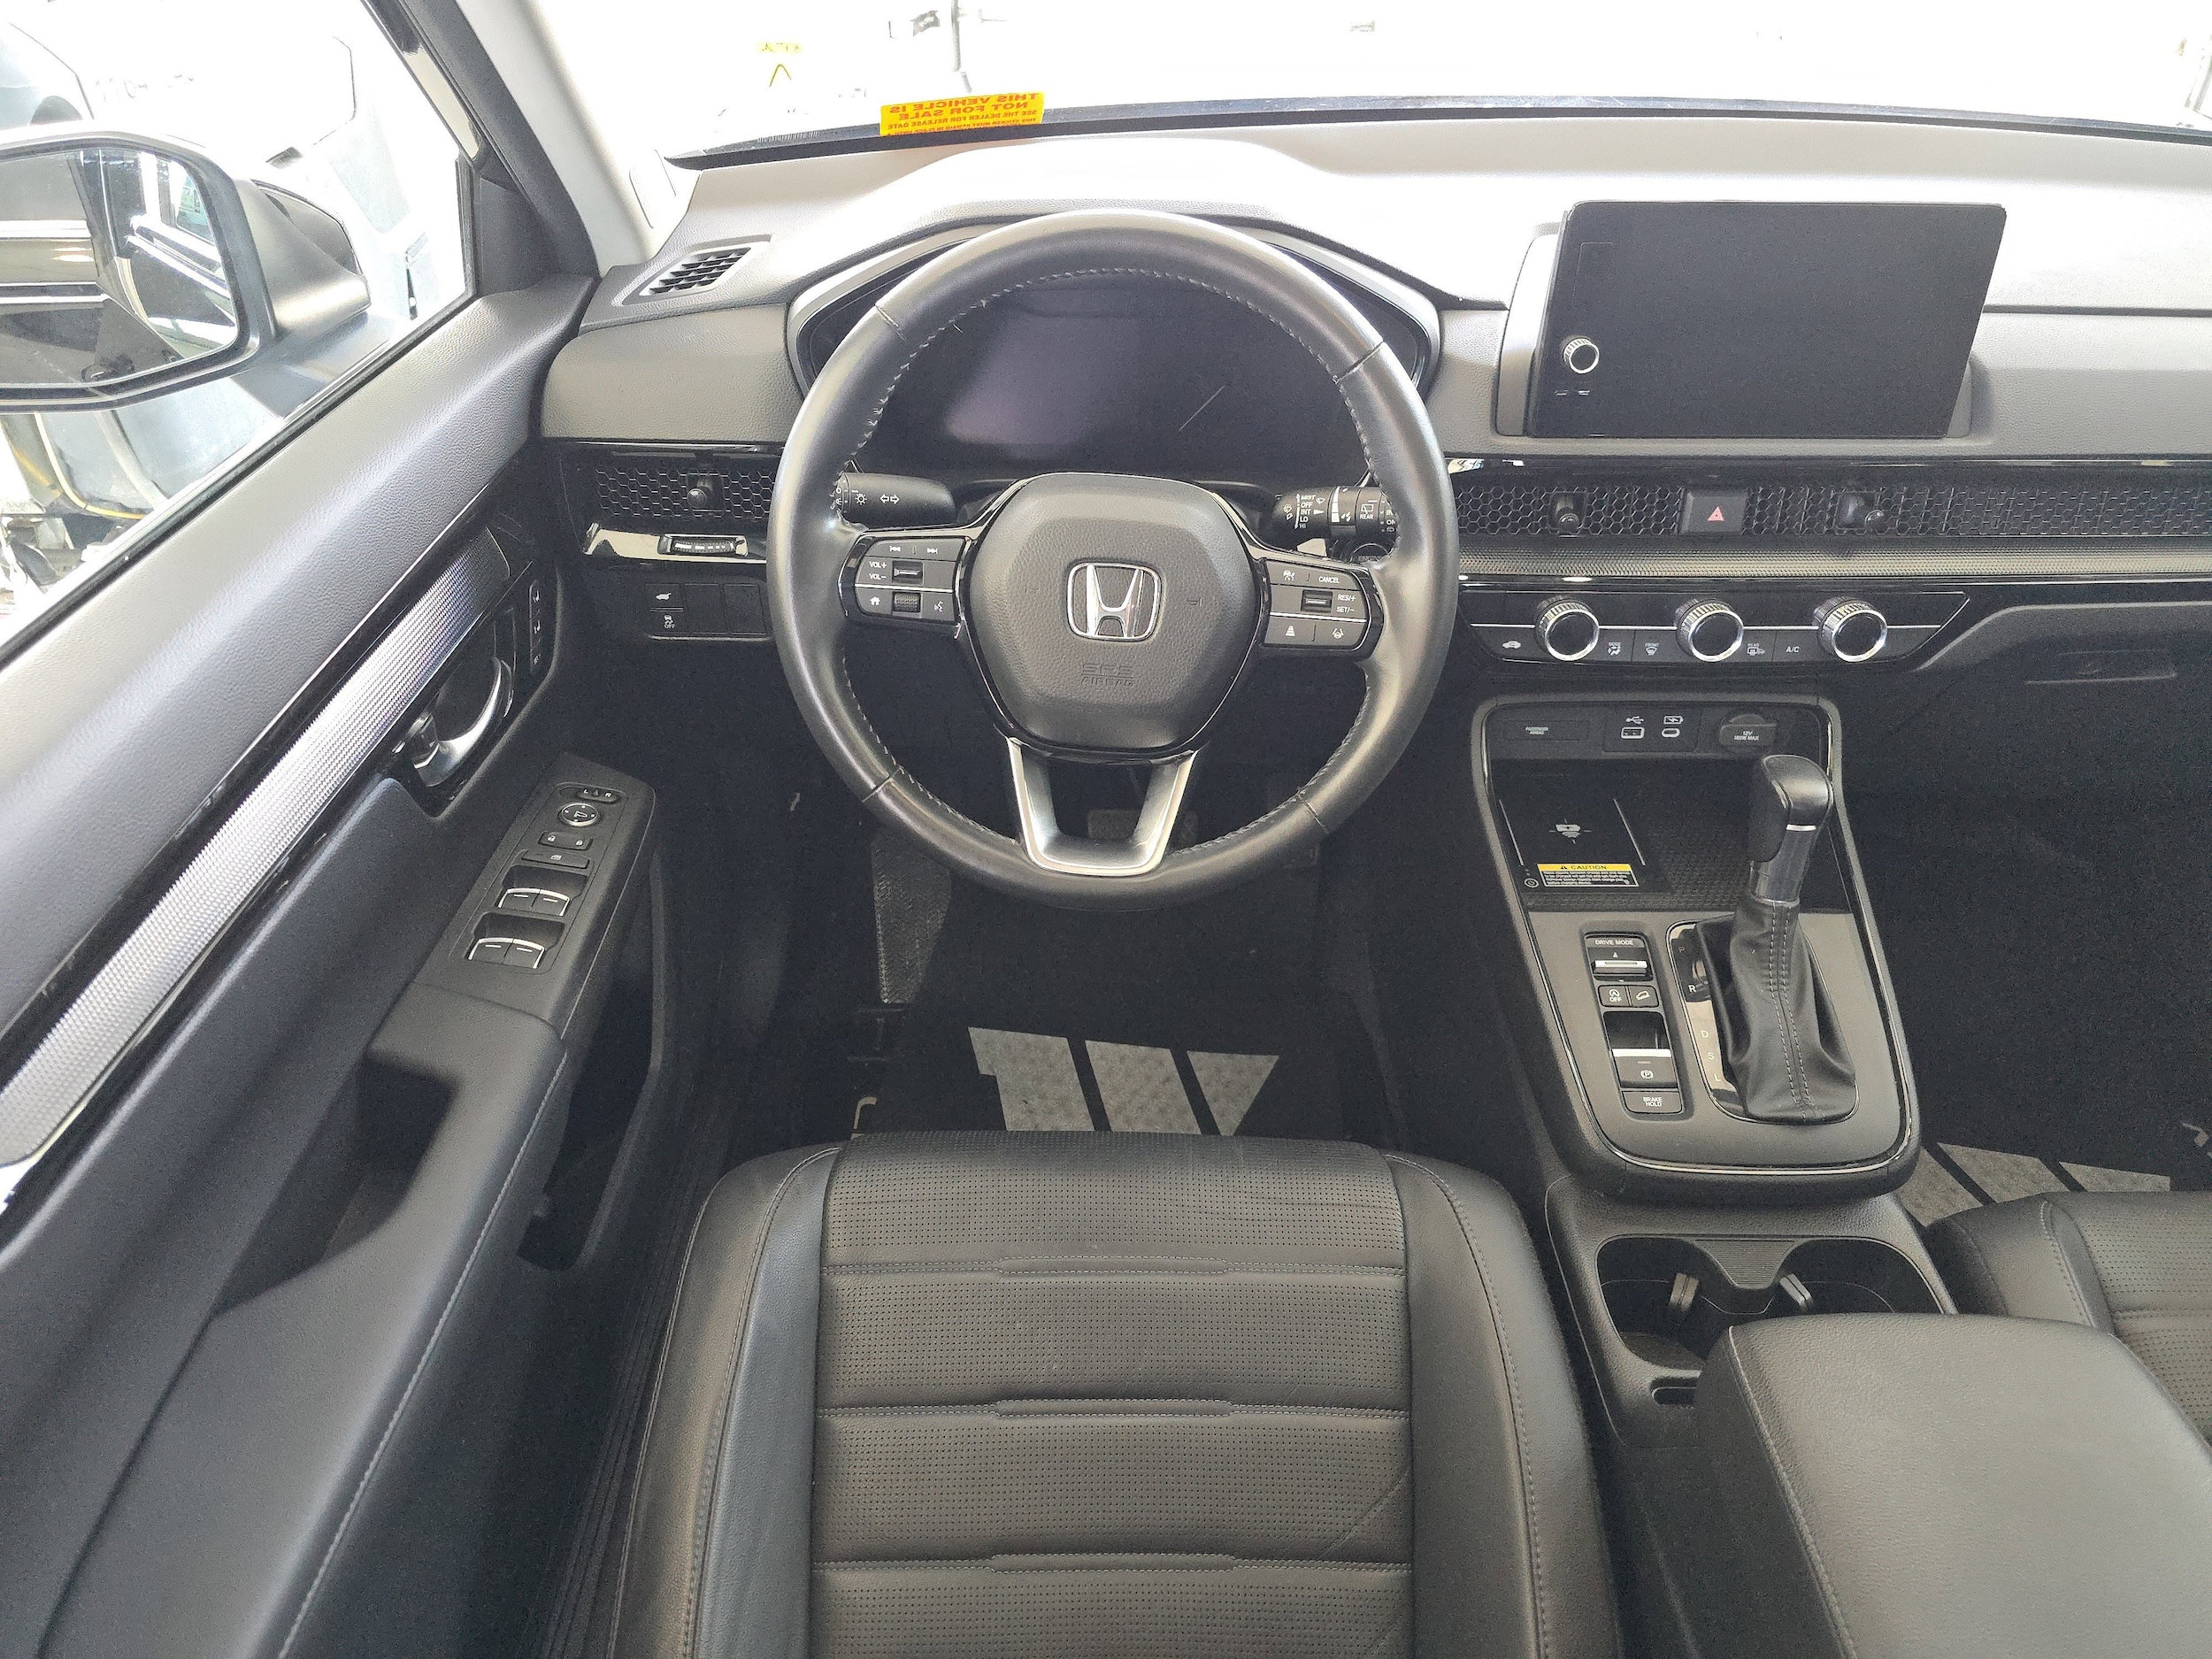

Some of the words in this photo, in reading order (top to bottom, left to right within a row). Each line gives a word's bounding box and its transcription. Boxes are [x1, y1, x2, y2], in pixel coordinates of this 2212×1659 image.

[1081, 664, 1134, 676] SRS
[1081, 677, 1134, 687] AIRBAG
[1701, 1030, 1709, 1039] D
